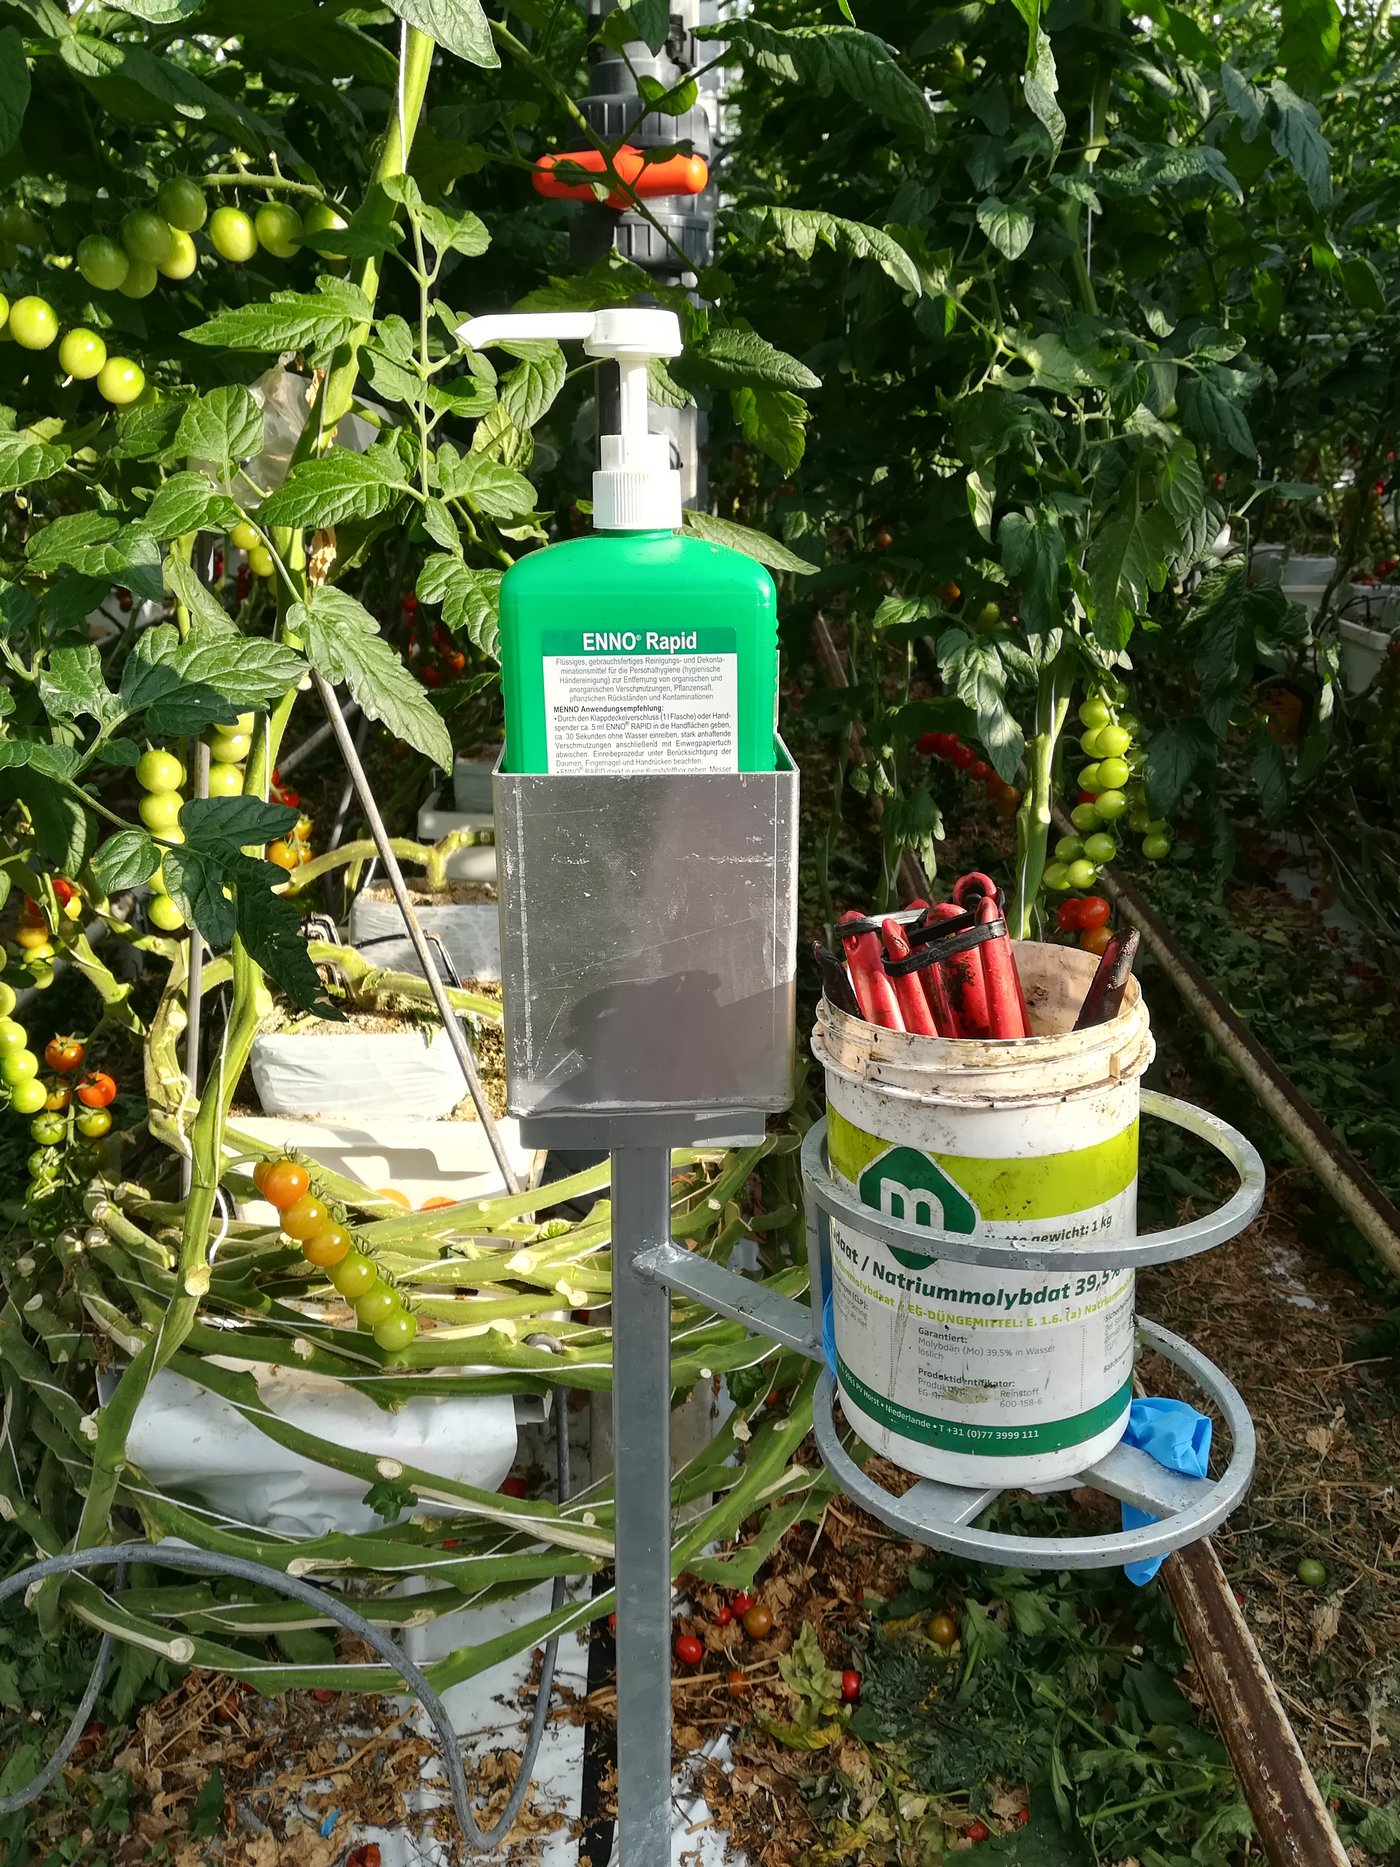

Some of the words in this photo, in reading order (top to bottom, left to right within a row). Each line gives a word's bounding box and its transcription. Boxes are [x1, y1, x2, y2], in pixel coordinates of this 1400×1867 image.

[646, 631, 697, 654] Rapid
[556, 658, 587, 667] Flüssiges,
[589, 657, 644, 666] gebrauchsfertiges
[645, 657, 682, 666] Reinigungs-
[684, 656, 695, 664] und
[697, 656, 725, 664] Dekonta-
[630, 666, 680, 675] Personalhygiene
[682, 665, 721, 674] (hygienische
[560, 677, 610, 685] Händereinigung)
[672, 675, 709, 683] organischen
[711, 674, 722, 682] und
[569, 686, 614, 694] anorganischen
[616, 685, 672, 693] Verschmutzungen,
[570, 695, 606, 703] pflanzlichen
[608, 694, 648, 702] Rückständen
[662, 693, 714, 701] Kontaminationen
[580, 705, 664, 713] Anwendungsempfehlung:
[590, 714, 659, 722] Klappdeckelverschluss
[697, 712, 711, 720] oder
[554, 724, 578, 732] spender
[631, 722, 652, 730] RAPID
[671, 721, 708, 729] Handflächen
[710, 720, 731, 730] geben,
[650, 731, 680, 739] einreiben,
[698, 730, 732, 738] anhaftende
[555, 742, 611, 750] Verschmutzungen
[616, 740, 658, 748] anschließend
[676, 740, 732, 748] Einwegpapiertuch
[593, 750, 644, 758] Einreibeprozedur
[667, 749, 718, 757] Berücksichtigung
[636, 758, 672, 766] Handrücken
[1091, 1221, 1097, 1232] 1
[1100, 1215, 1112, 1228] kg
[873, 1261, 1070, 1310] Natriummolybdat
[907, 1303, 1023, 1328] EG-DÜNGEMITTEL:
[1026, 1319, 1037, 1328] E.
[1041, 1315, 1062, 1326] 1.6.
[1065, 1308, 1081, 1322] (a)
[918, 1327, 968, 1343] Garantiert:
[918, 1337, 960, 1354] Molybdän
[962, 1346, 984, 1356] (Mo)
[986, 1349, 1013, 1357] 39,5%
[1026, 1345, 1056, 1355] Wasser
[918, 1367, 1015, 1388] Produktidentifikator:
[1000, 1388, 1039, 1398] Reinstoff
[1000, 1398, 1043, 1408] 600-158-6
[863, 1388, 880, 1407] Horst
[885, 1404, 931, 1429] Niederlande
[939, 1424, 945, 1432] T
[947, 1427, 964, 1437] +31
[966, 1429, 993, 1440] (0)77
[996, 1432, 1020, 1440] 3999
[1022, 1430, 1039, 1439] 111
